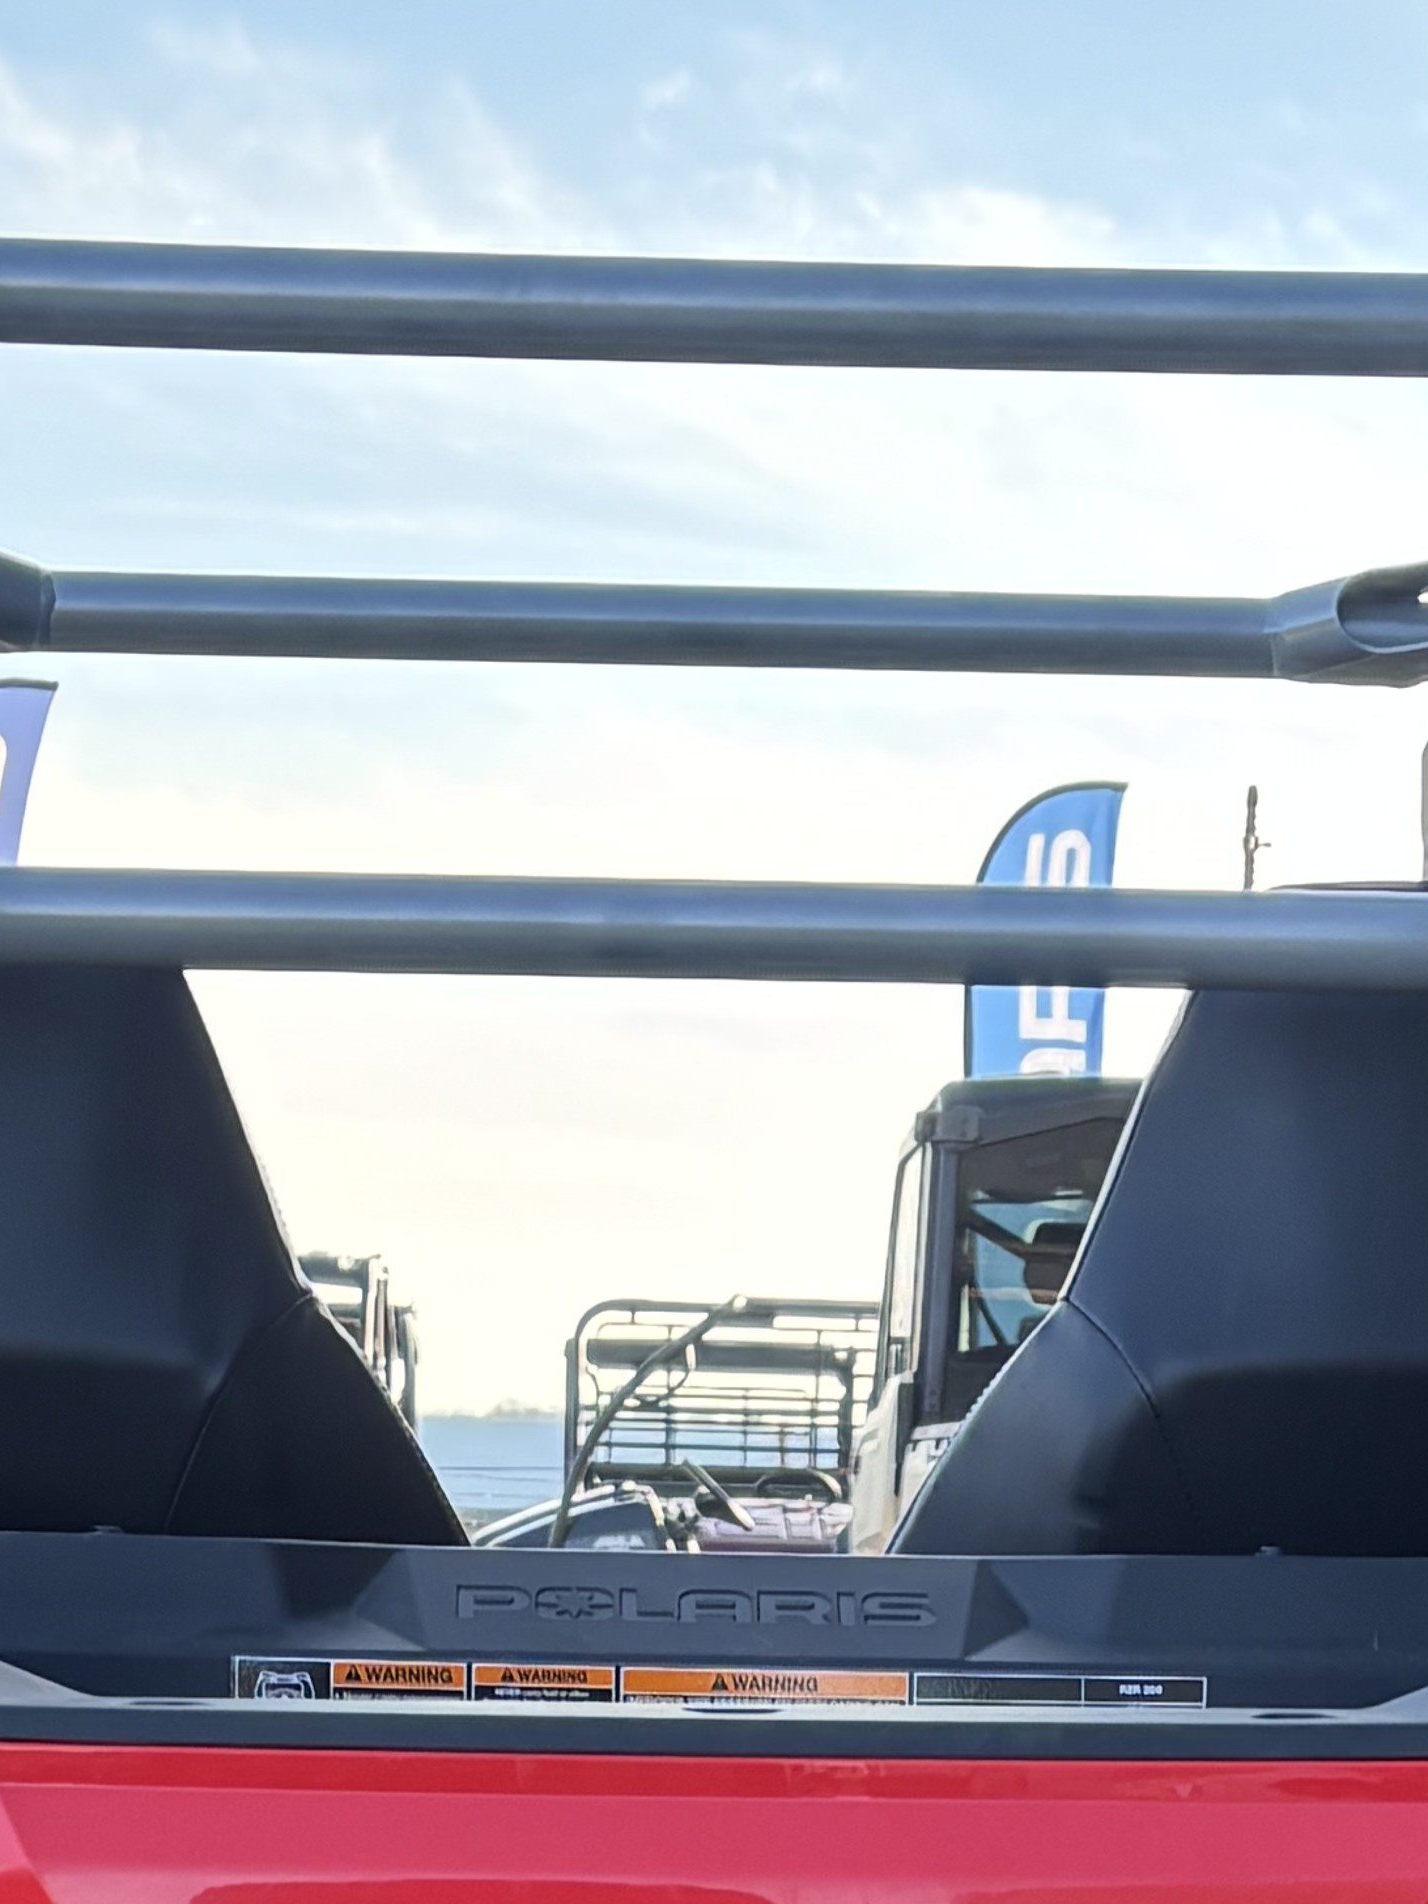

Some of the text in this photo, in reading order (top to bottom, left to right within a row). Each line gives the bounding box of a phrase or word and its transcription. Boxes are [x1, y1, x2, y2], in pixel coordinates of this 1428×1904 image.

[457, 1585, 937, 1626] POLARIS
[365, 1664, 454, 1684] WARNING
[517, 1667, 588, 1684] WARNING
[732, 1673, 818, 1693] WARNING
